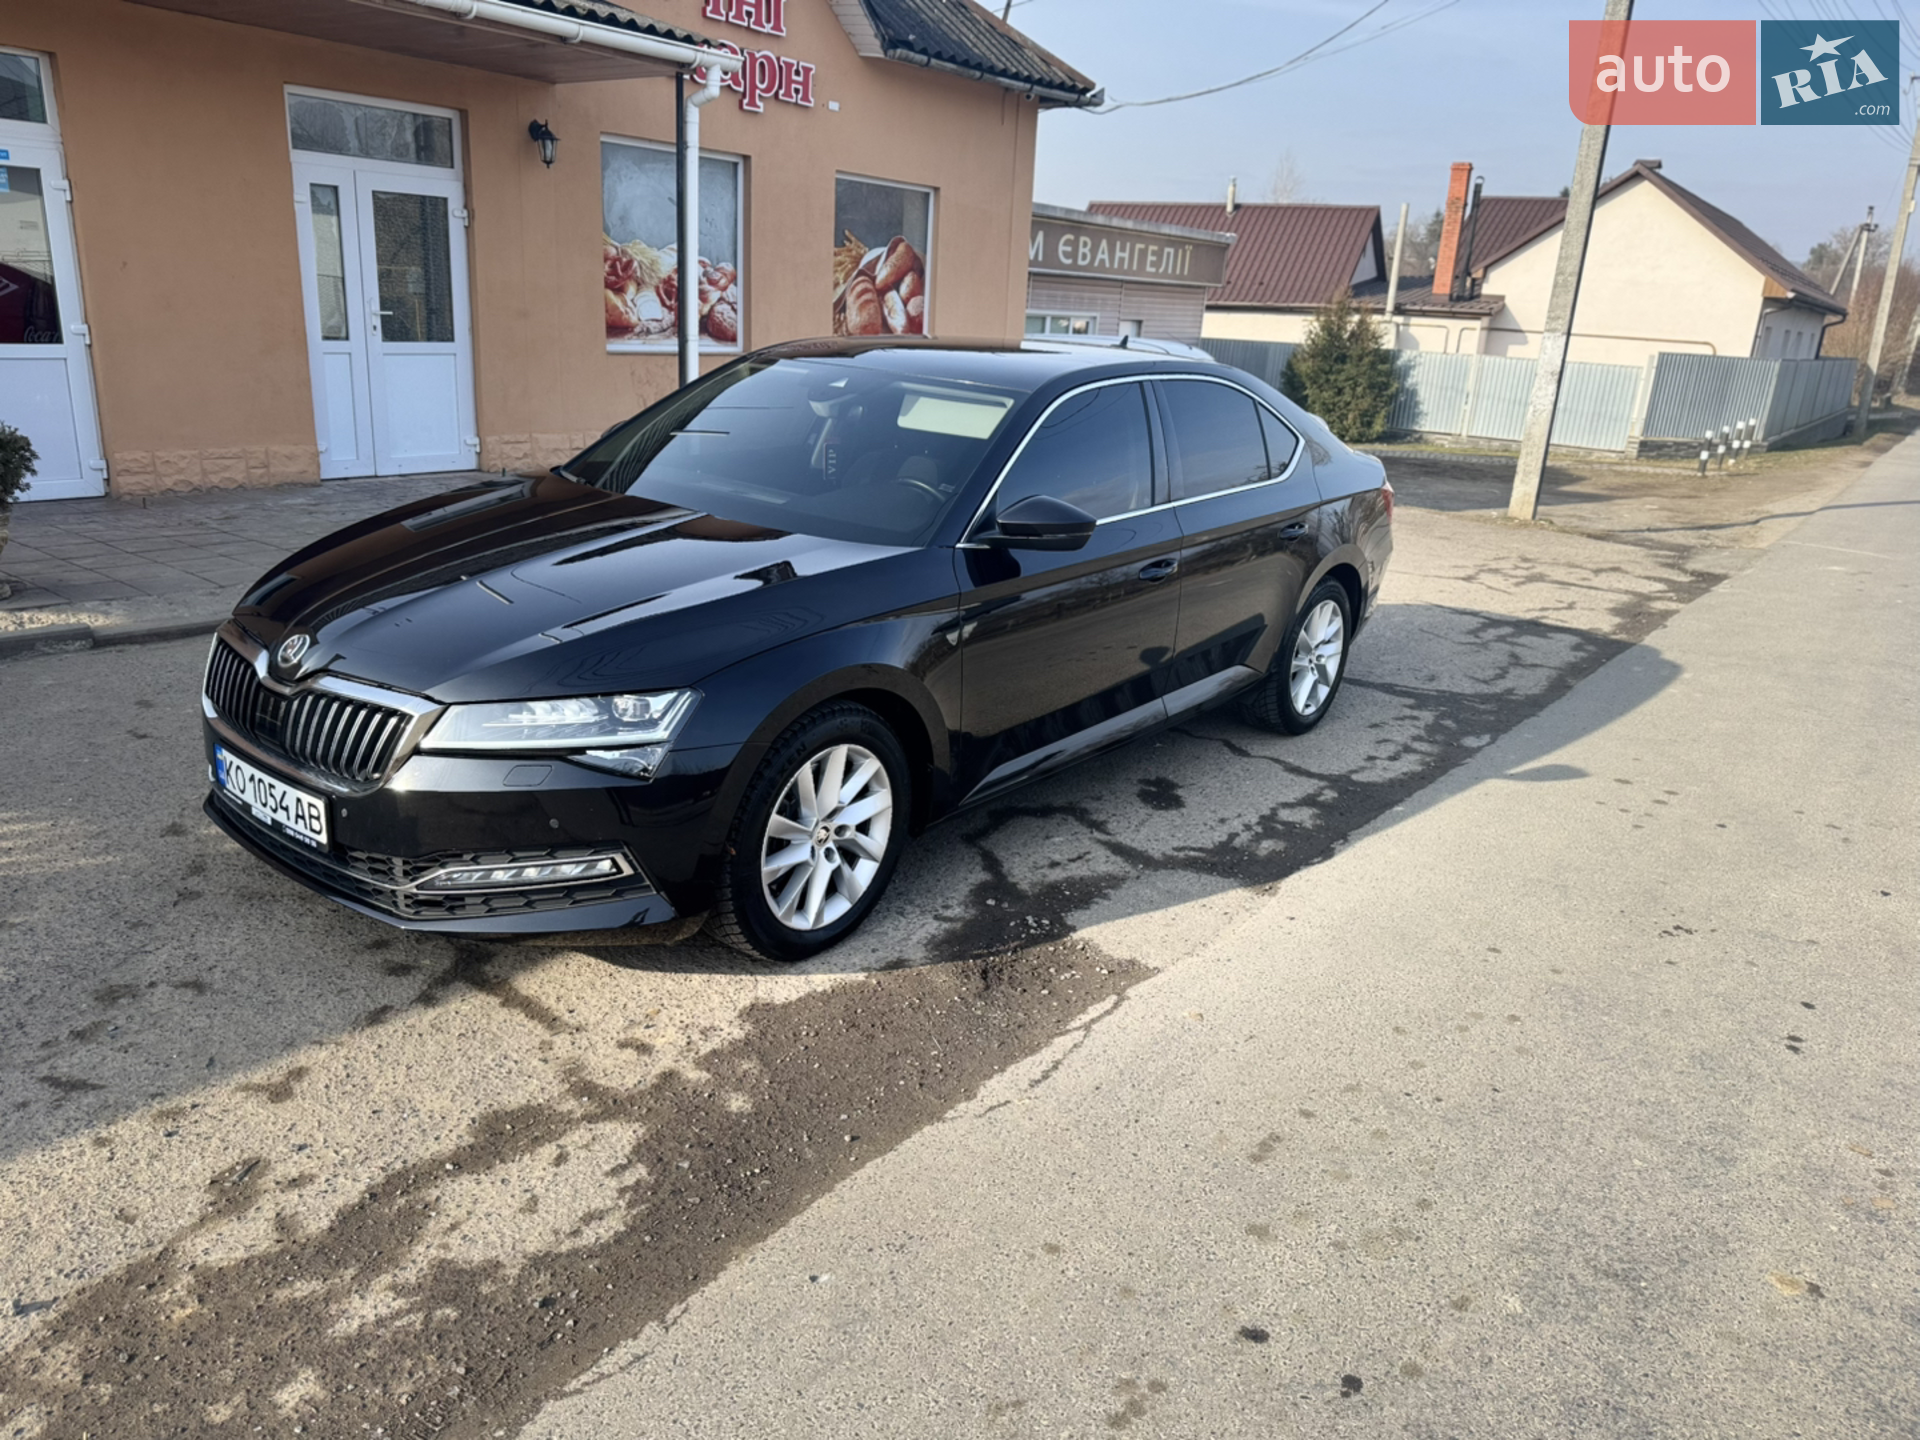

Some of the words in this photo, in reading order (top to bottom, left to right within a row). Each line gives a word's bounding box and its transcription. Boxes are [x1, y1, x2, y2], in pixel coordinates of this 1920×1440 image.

[1058, 233, 1193, 276] ЄВАНГЕЛІЇ
[224, 756, 246, 795] KO
[248, 772, 290, 822] 1054
[294, 796, 323, 836] AB
